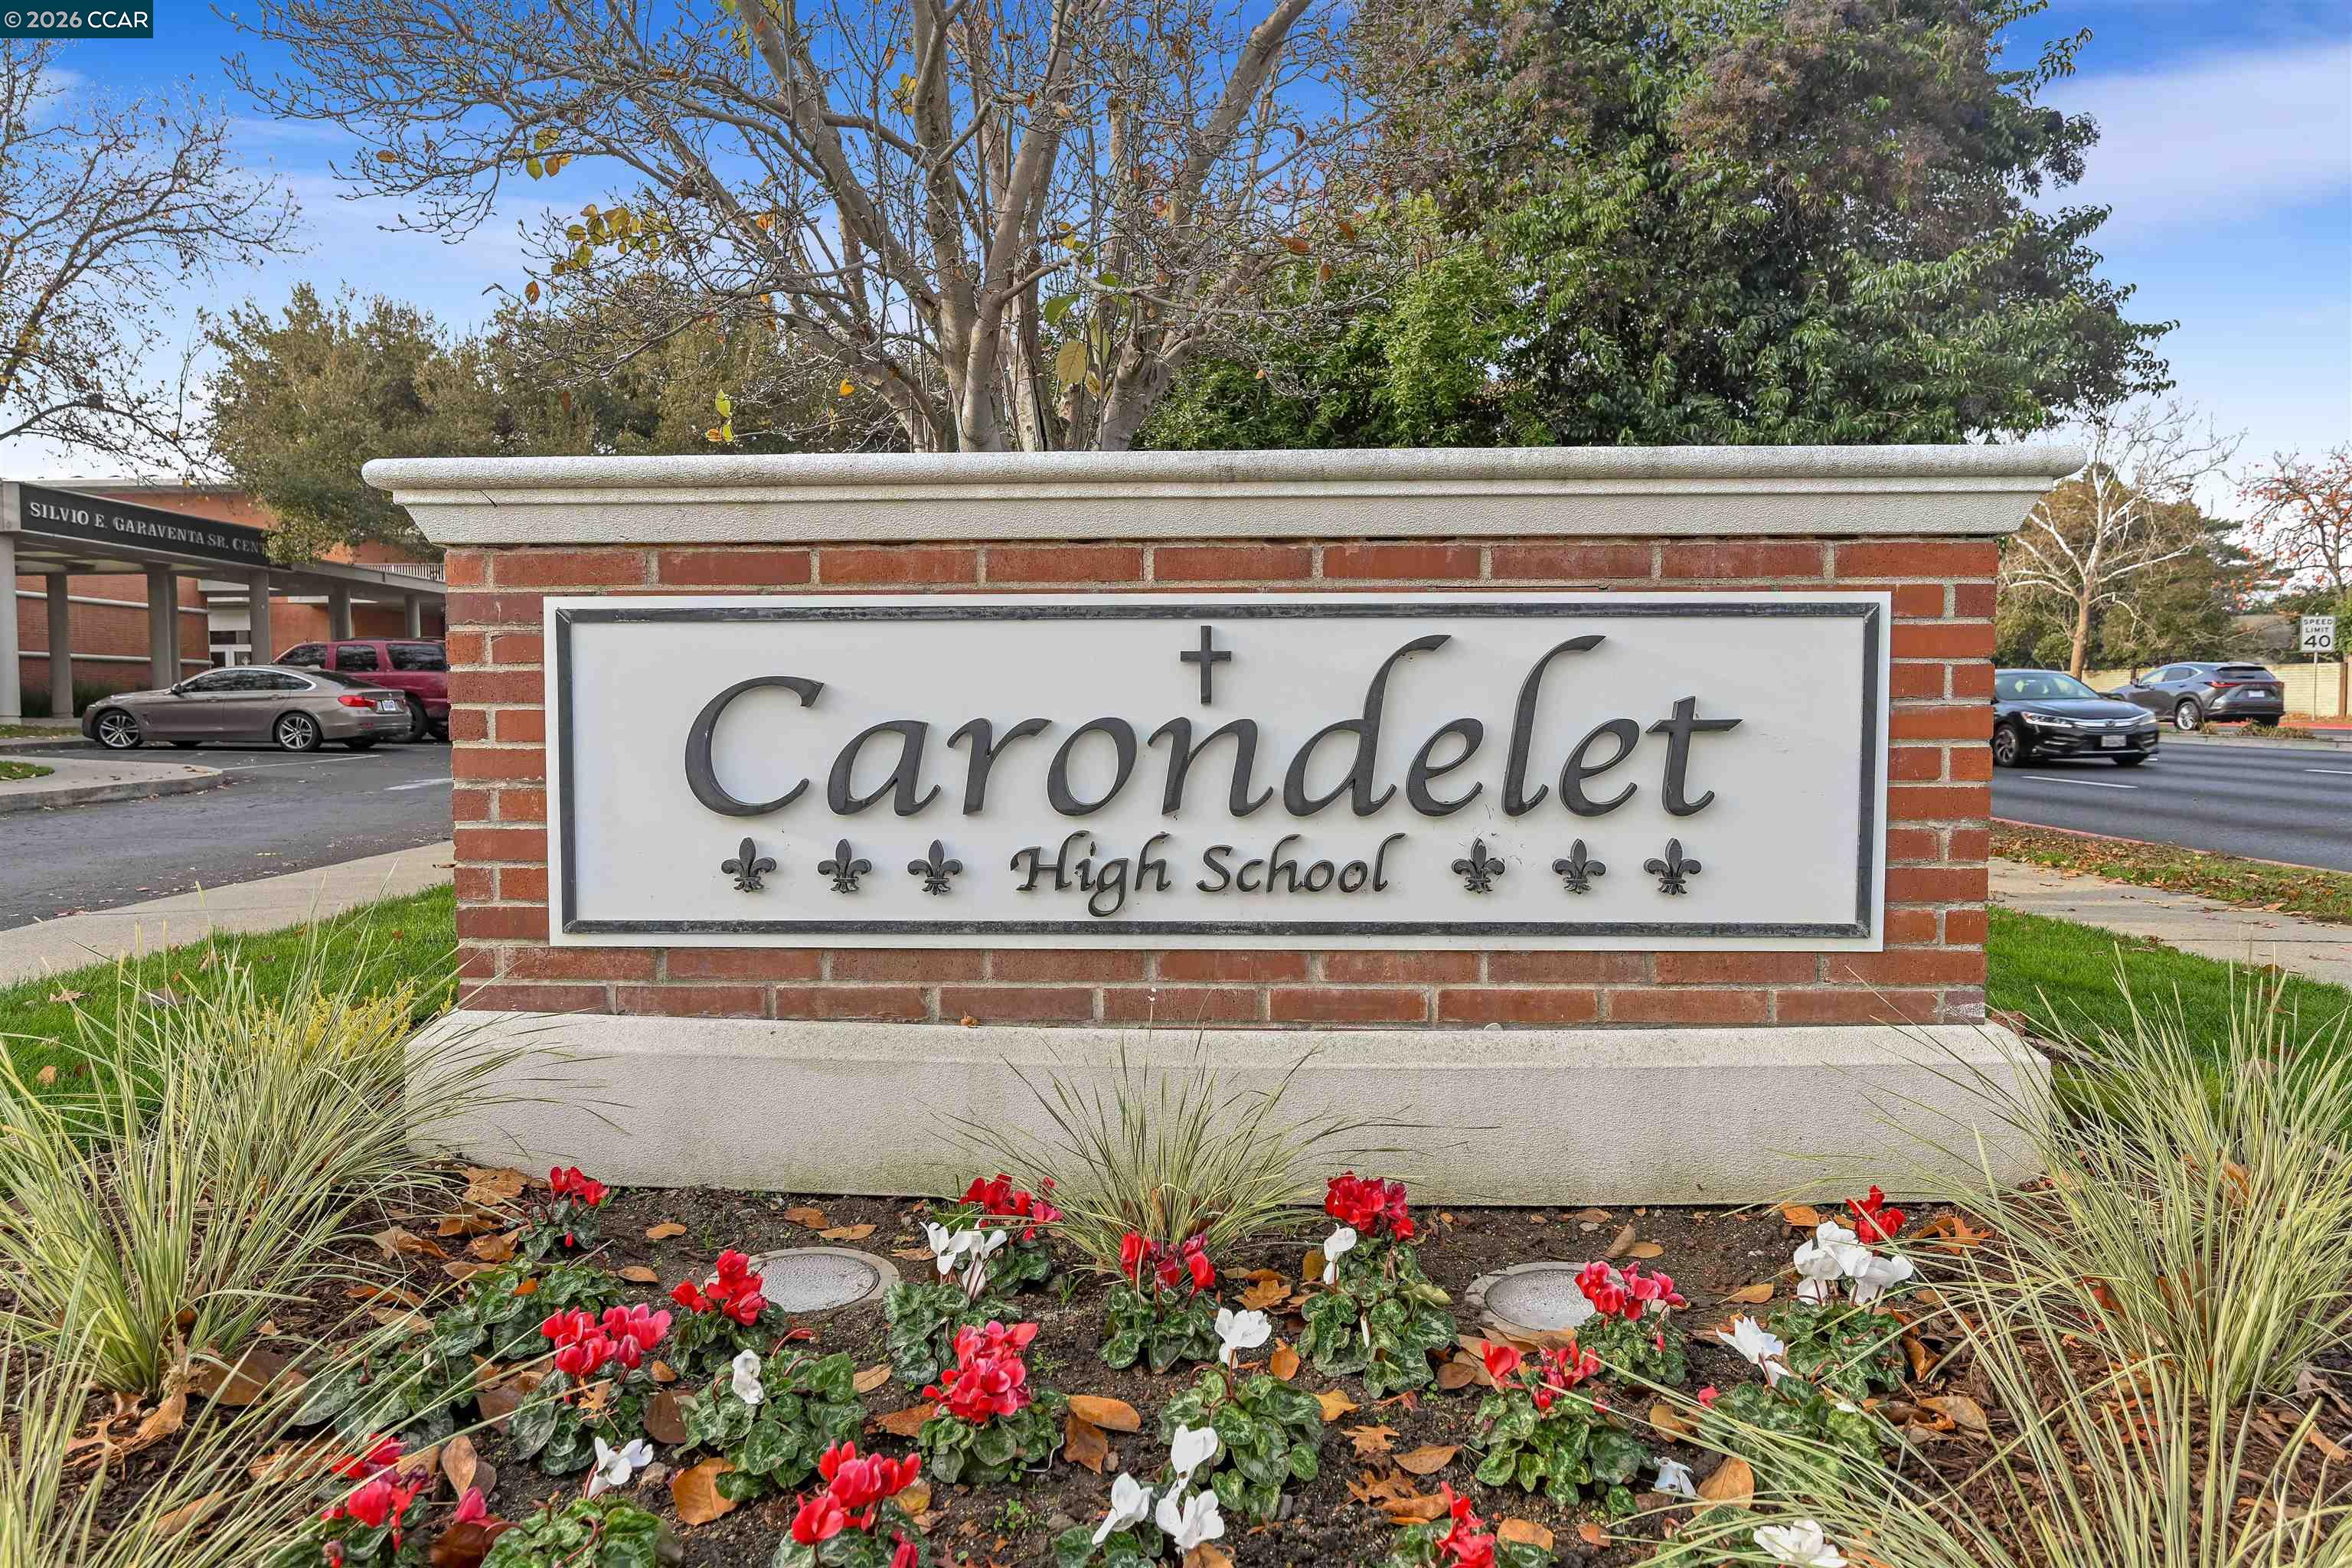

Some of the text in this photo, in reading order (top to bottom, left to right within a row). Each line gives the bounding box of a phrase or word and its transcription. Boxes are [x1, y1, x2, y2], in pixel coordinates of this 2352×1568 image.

[30, 501, 90, 525] SILVIO
[94, 515, 108, 530] E.
[113, 517, 204, 544] GARAVENTA
[207, 534, 230, 549] SR.
[2304, 635, 2331, 648] 40
[684, 634, 1743, 818] Carondelet
[1010, 830, 1407, 918] High School
